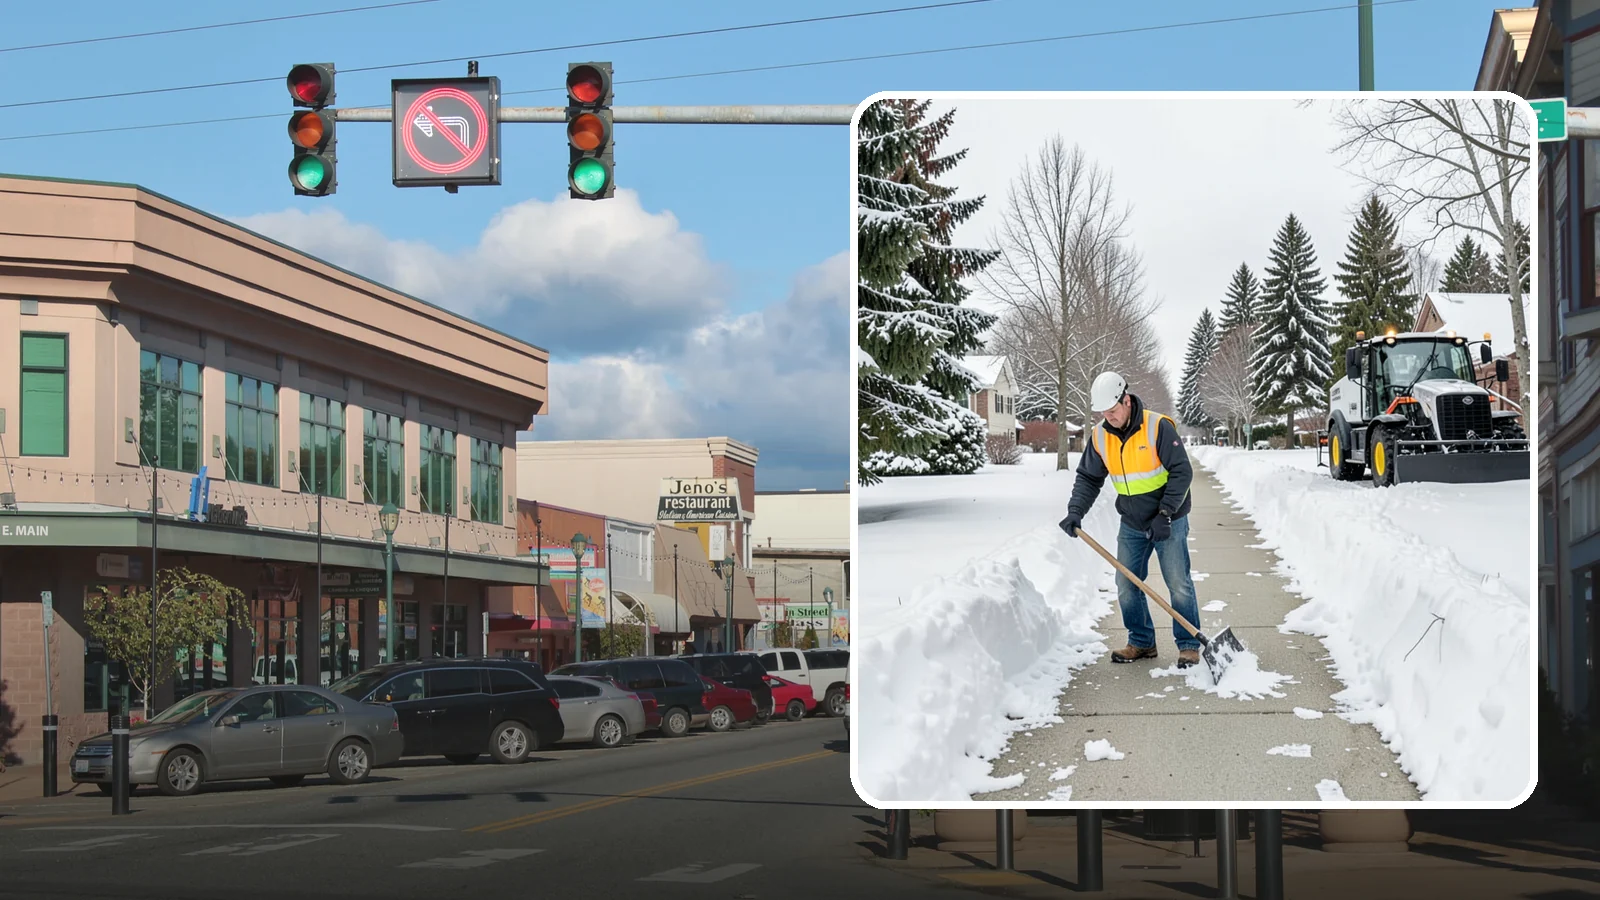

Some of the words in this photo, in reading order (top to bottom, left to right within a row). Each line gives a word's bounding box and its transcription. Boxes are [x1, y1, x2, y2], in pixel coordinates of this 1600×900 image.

[670, 480, 727, 494] Jeno's
[665, 496, 730, 508] restaurant
[686, 510, 714, 518] American
[715, 509, 737, 518] Cuisine
[2, 525, 12, 536] E.
[16, 525, 48, 536] MAIN
[797, 607, 828, 616] Street
